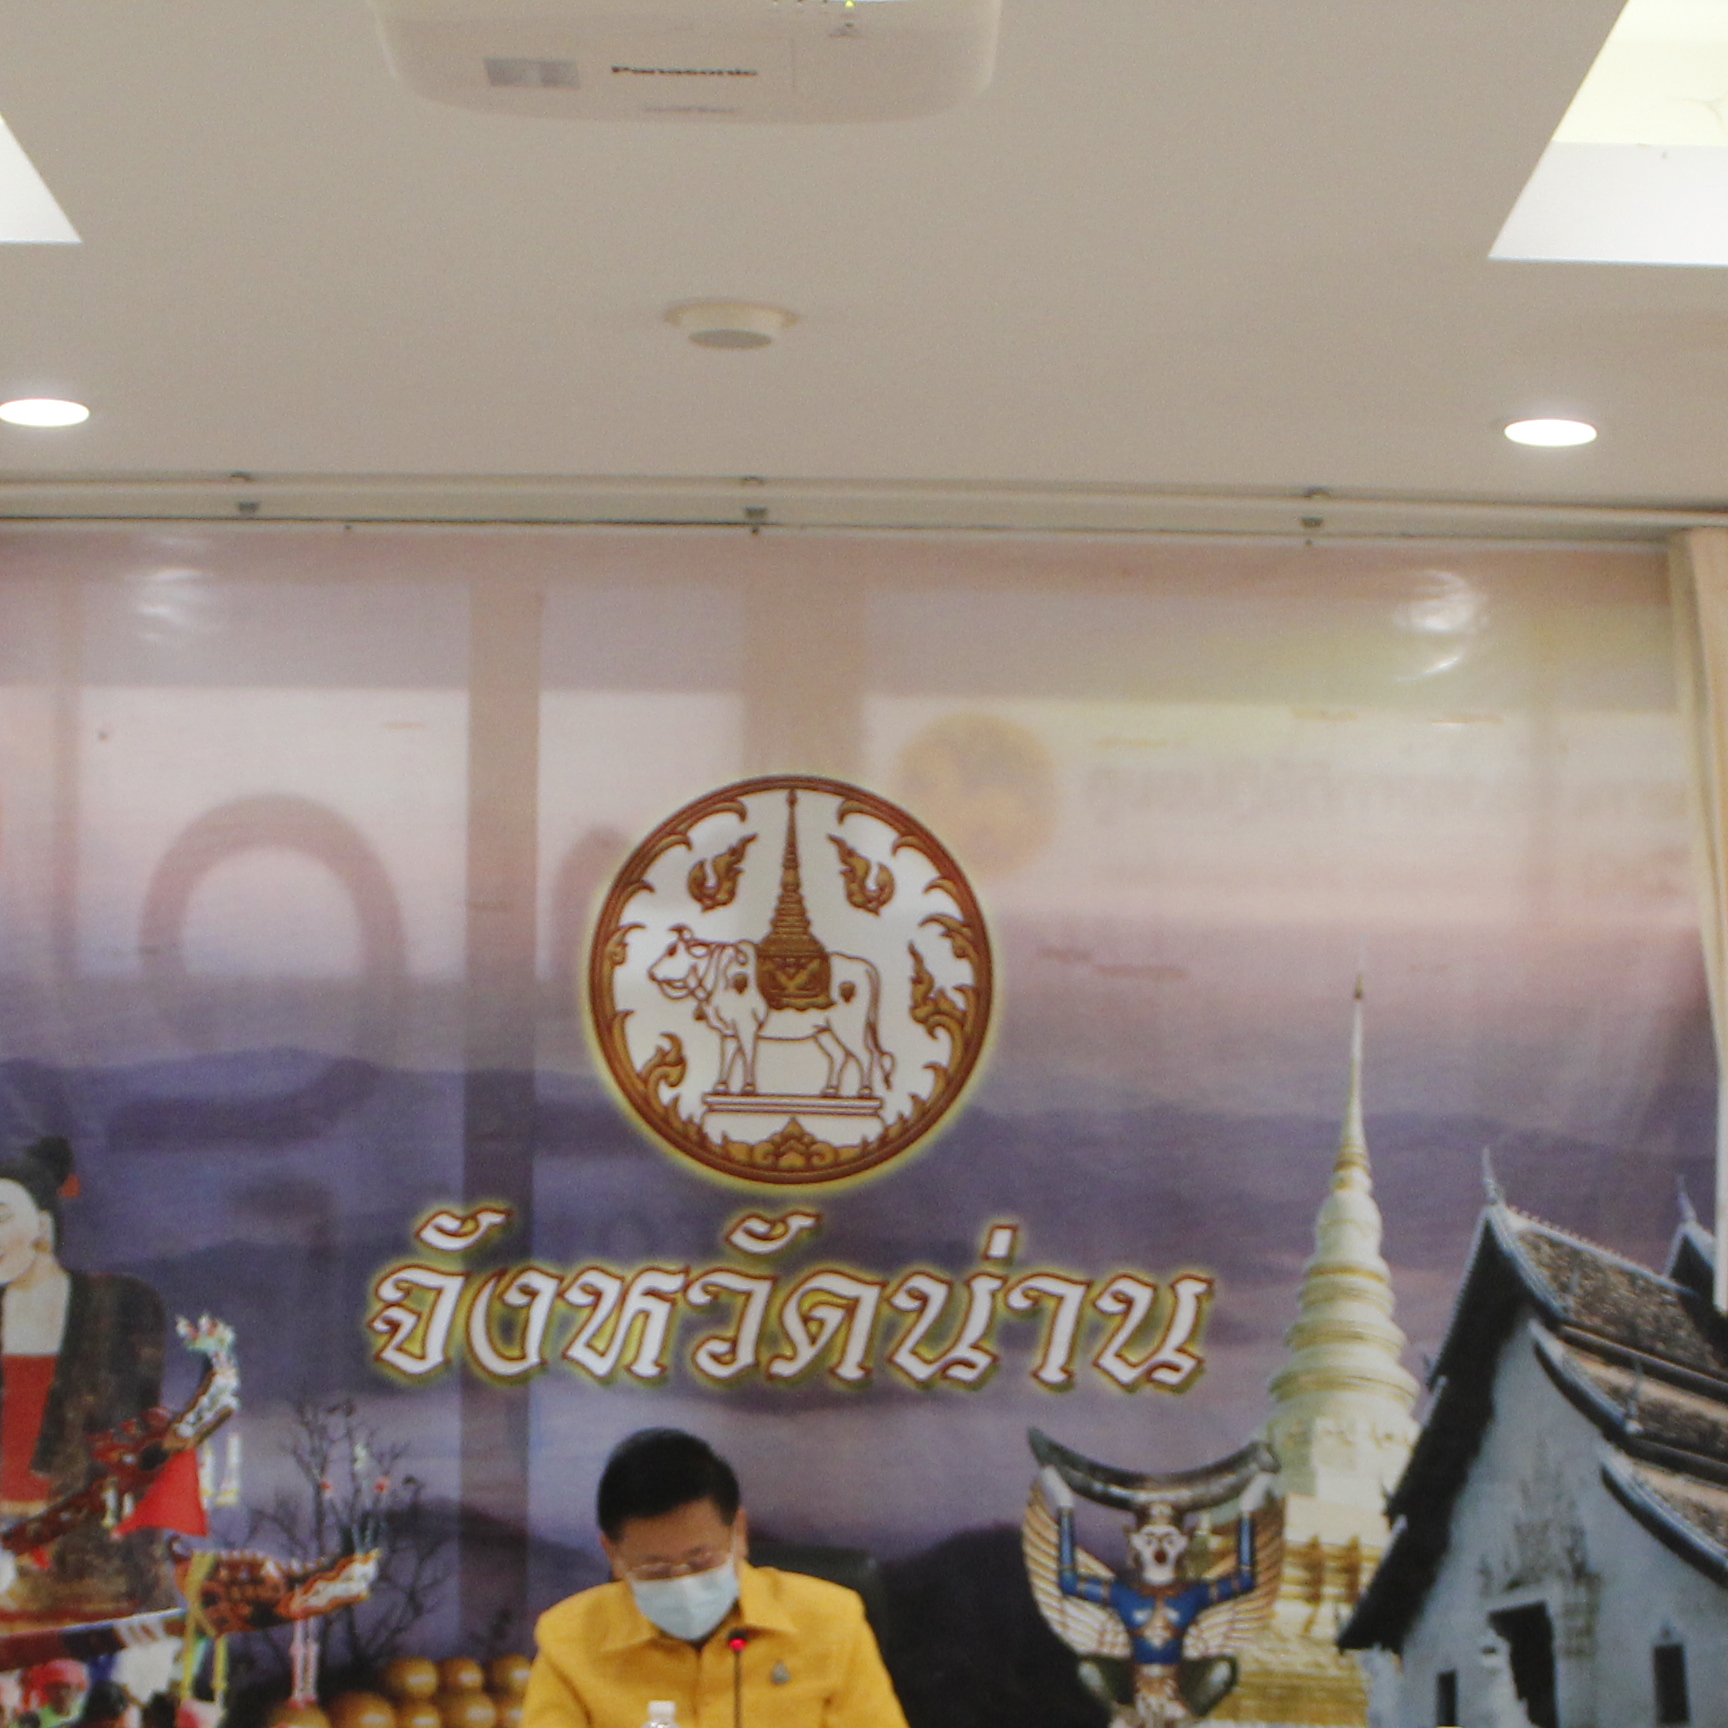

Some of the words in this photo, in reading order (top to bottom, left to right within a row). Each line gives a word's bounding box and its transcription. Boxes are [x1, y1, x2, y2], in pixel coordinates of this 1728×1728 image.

[366, 1206, 1214, 1394] จังหวัดน่าน
